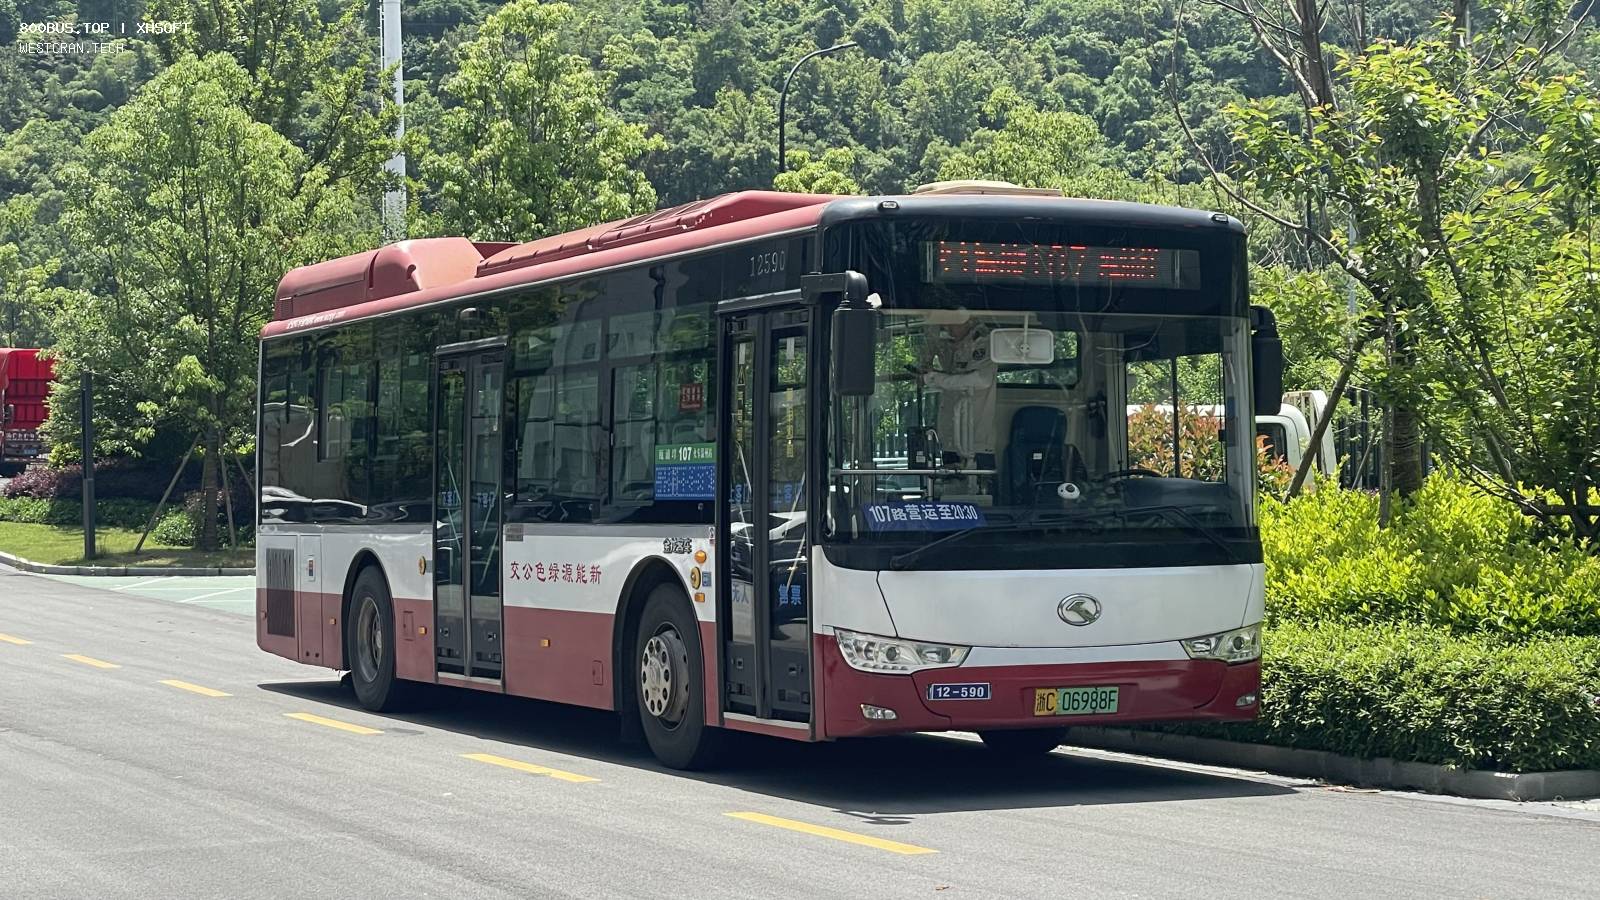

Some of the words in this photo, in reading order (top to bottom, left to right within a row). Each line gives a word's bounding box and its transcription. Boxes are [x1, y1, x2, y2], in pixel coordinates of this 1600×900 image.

[750, 251, 785, 277] 12590
[678, 447, 691, 461] 107
[936, 686, 985, 699] 12-590
